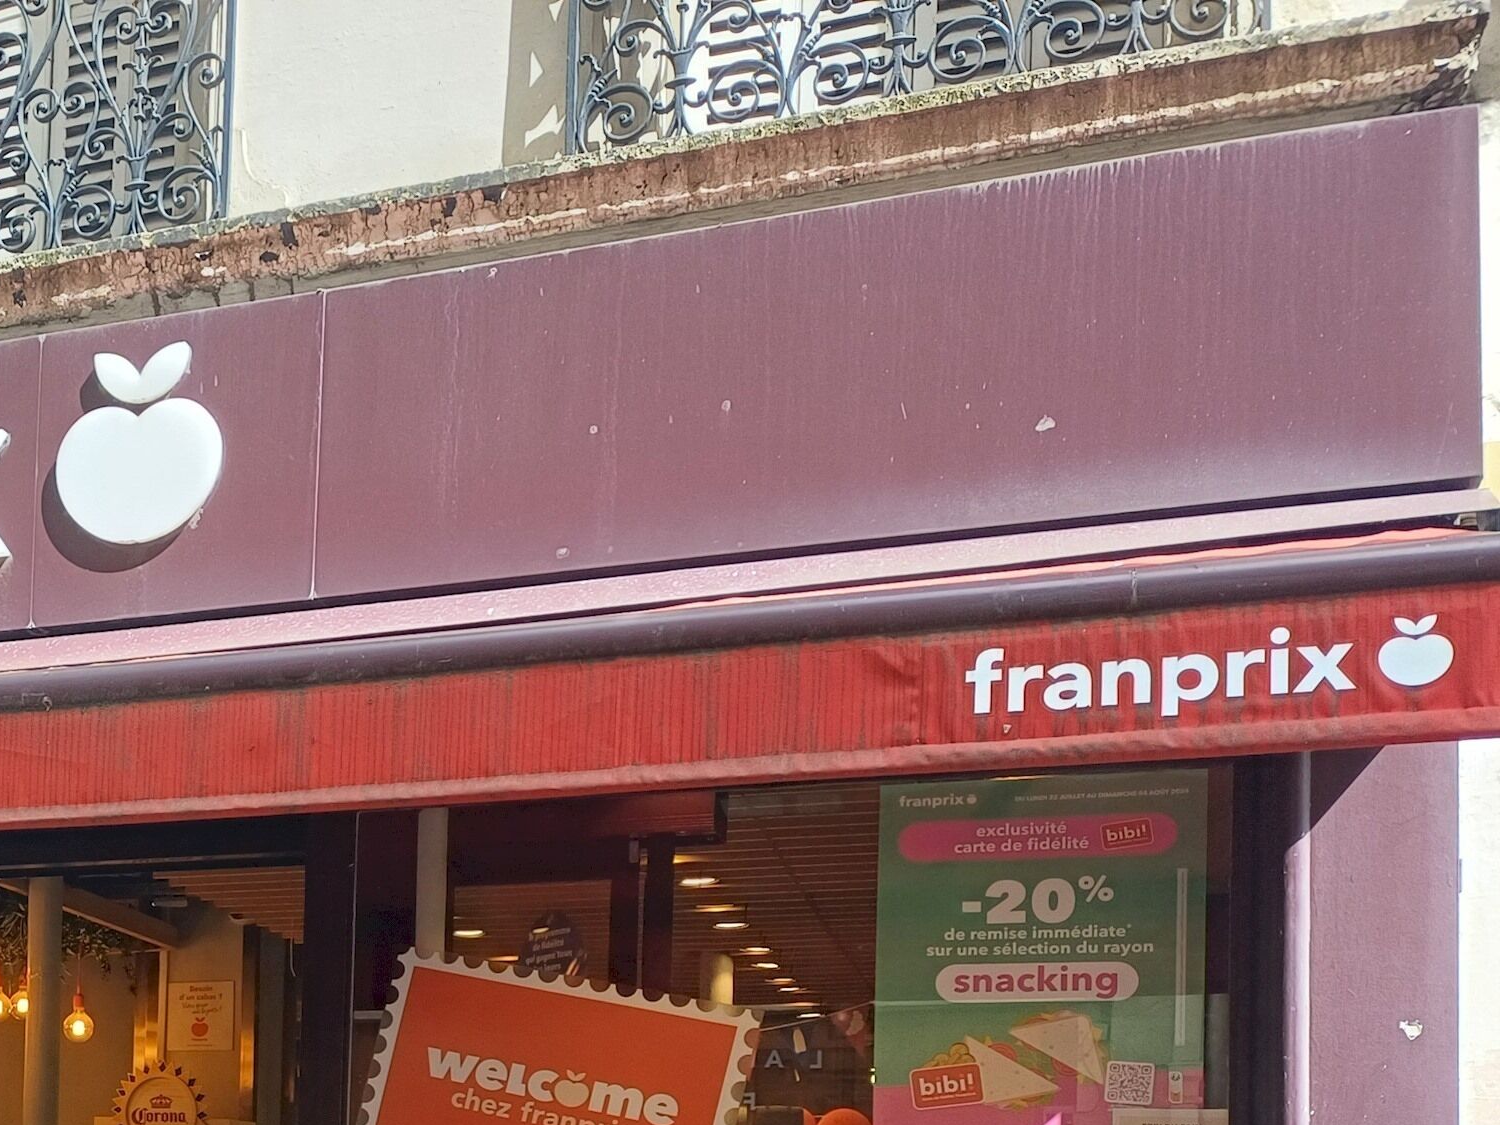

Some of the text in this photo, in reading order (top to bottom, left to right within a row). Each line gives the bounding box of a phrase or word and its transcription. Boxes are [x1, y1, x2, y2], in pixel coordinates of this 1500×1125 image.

[965, 626, 1357, 717] franprix
[899, 793, 965, 810] franprix
[975, 821, 1068, 838] exclusivité
[1106, 824, 1147, 842] bibi!
[954, 836, 1089, 855] carte de fidélité
[962, 874, 1114, 925] -20%
[944, 928, 965, 941] de
[970, 927, 1028, 941] remise
[926, 941, 1154, 957] sur une sélection du rayon
[953, 964, 1119, 999] snacking
[919, 1072, 974, 1096] bibi!
[451, 1087, 512, 1119] chez
